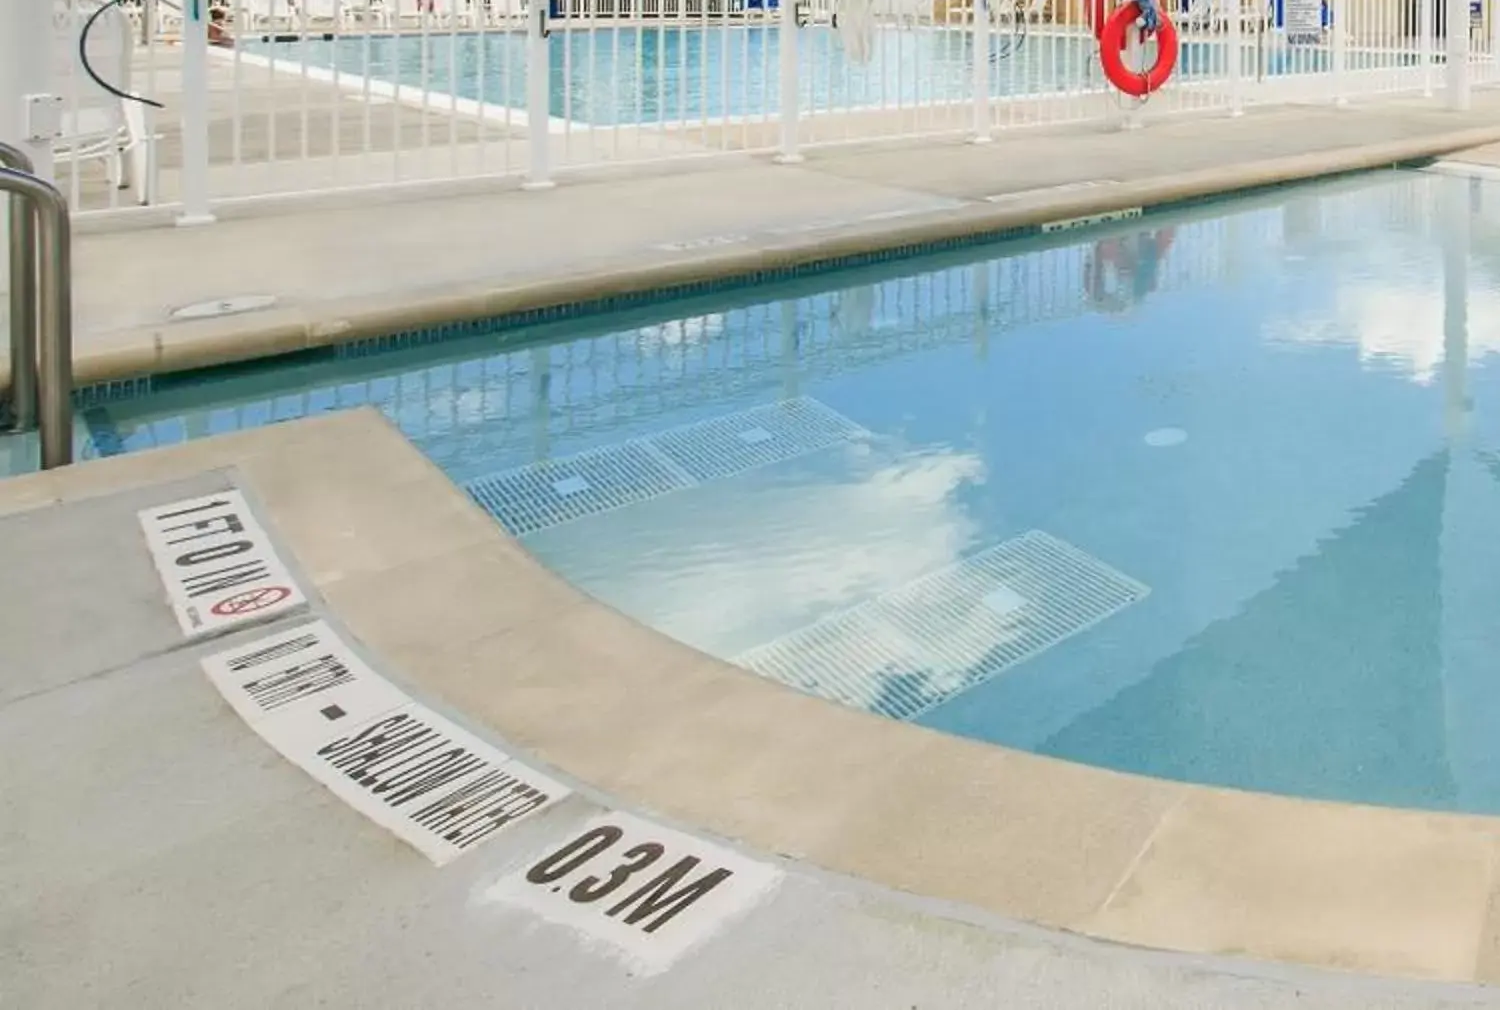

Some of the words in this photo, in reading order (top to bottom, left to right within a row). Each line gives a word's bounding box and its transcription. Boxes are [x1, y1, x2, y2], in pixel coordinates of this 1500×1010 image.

[162, 513, 245, 546] FT
[181, 559, 271, 598] IN
[316, 713, 488, 808] SHALLOW
[408, 766, 549, 849] WATER
